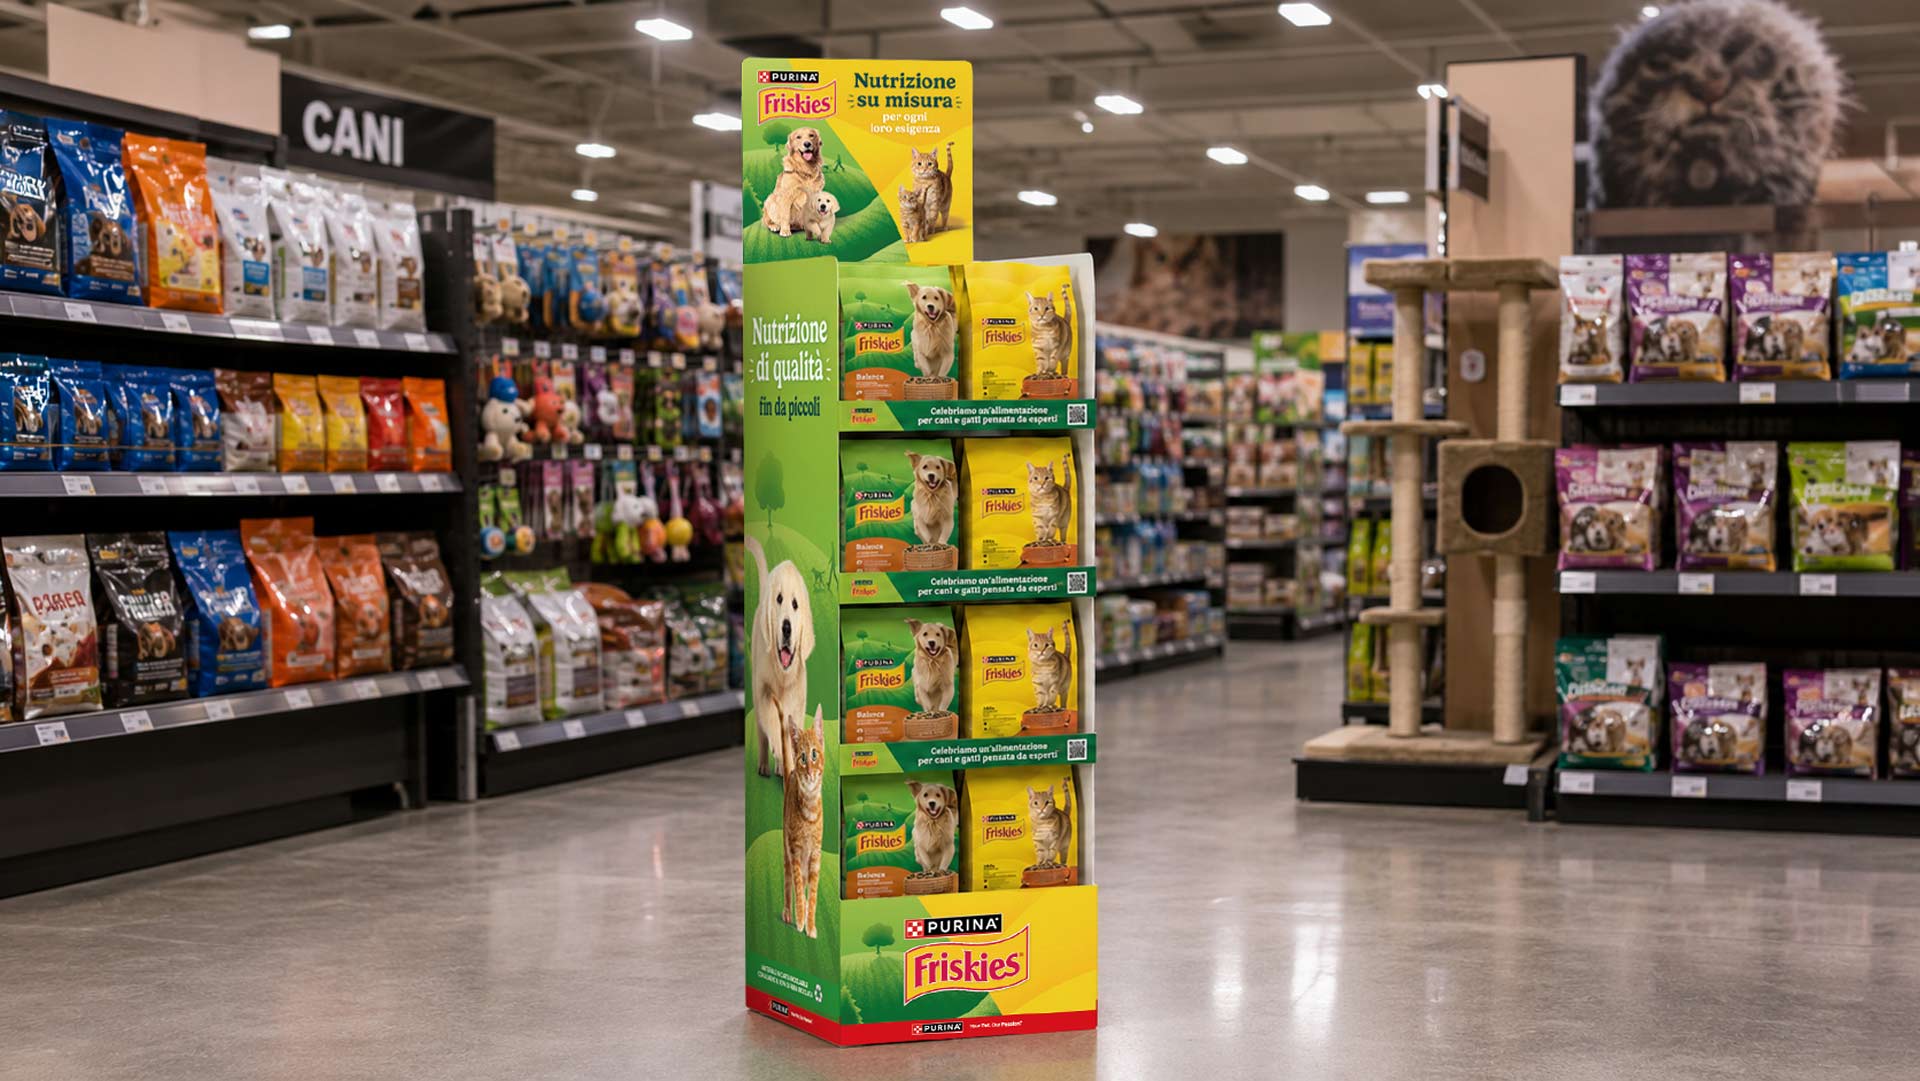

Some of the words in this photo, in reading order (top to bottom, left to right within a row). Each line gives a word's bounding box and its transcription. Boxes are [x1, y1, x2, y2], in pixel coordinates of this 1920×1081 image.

[772, 72, 818, 82] PURINA
[854, 72, 956, 90] Nutrizione
[764, 92, 831, 115] Friskies
[856, 95, 880, 108] su
[886, 92, 954, 108] misura
[882, 114, 902, 124] per
[903, 112, 928, 123] ogni
[303, 100, 404, 167] CANI
[870, 124, 892, 134] loro
[895, 123, 940, 134] esigenza
[752, 314, 828, 345] Nutrizione
[986, 330, 1022, 344] Friskies
[860, 336, 901, 351] Friskies
[756, 352, 769, 382] di
[773, 349, 824, 389] qualità
[760, 396, 772, 416] fin
[775, 396, 786, 416] da
[788, 396, 820, 421] piccoli
[930, 406, 977, 415] Celebriamo
[918, 417, 932, 426] per
[1028, 414, 1058, 425] esperti
[860, 504, 901, 520] Friskies
[986, 500, 1022, 513] Friskies
[930, 576, 977, 586] Celebriamo
[918, 588, 932, 597] per
[1028, 584, 1058, 593] esperti
[860, 673, 902, 688] Friskies
[986, 668, 1022, 681] Friskies
[918, 756, 932, 766] per
[1028, 750, 1058, 760] esperti
[930, 746, 977, 755] Celebriamo
[986, 826, 1022, 840] Friskies
[860, 834, 902, 850] Friskies
[928, 918, 998, 934] PURINA
[914, 950, 1020, 988] Friskies
[924, 1024, 960, 1032] PURINA
